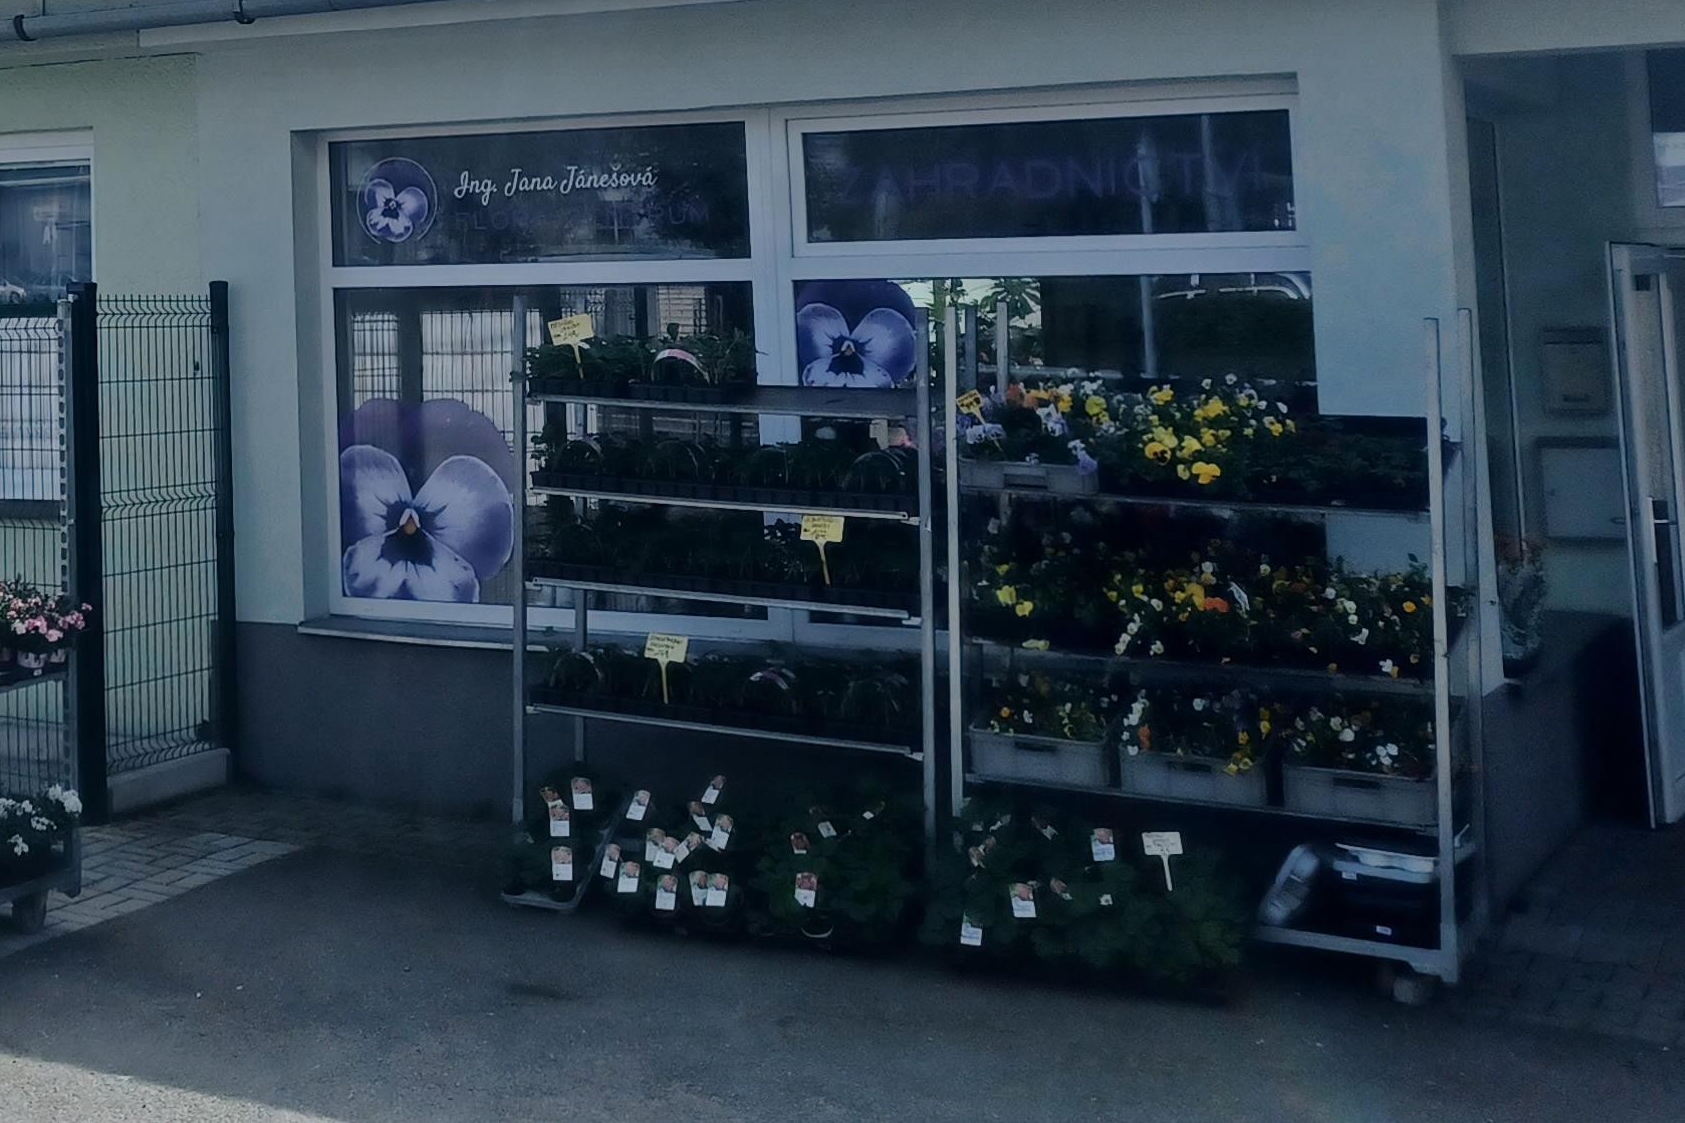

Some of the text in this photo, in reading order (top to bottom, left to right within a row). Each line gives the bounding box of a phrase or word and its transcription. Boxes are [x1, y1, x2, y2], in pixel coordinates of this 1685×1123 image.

[454, 162, 658, 206] Ing. Jana Jánešová
